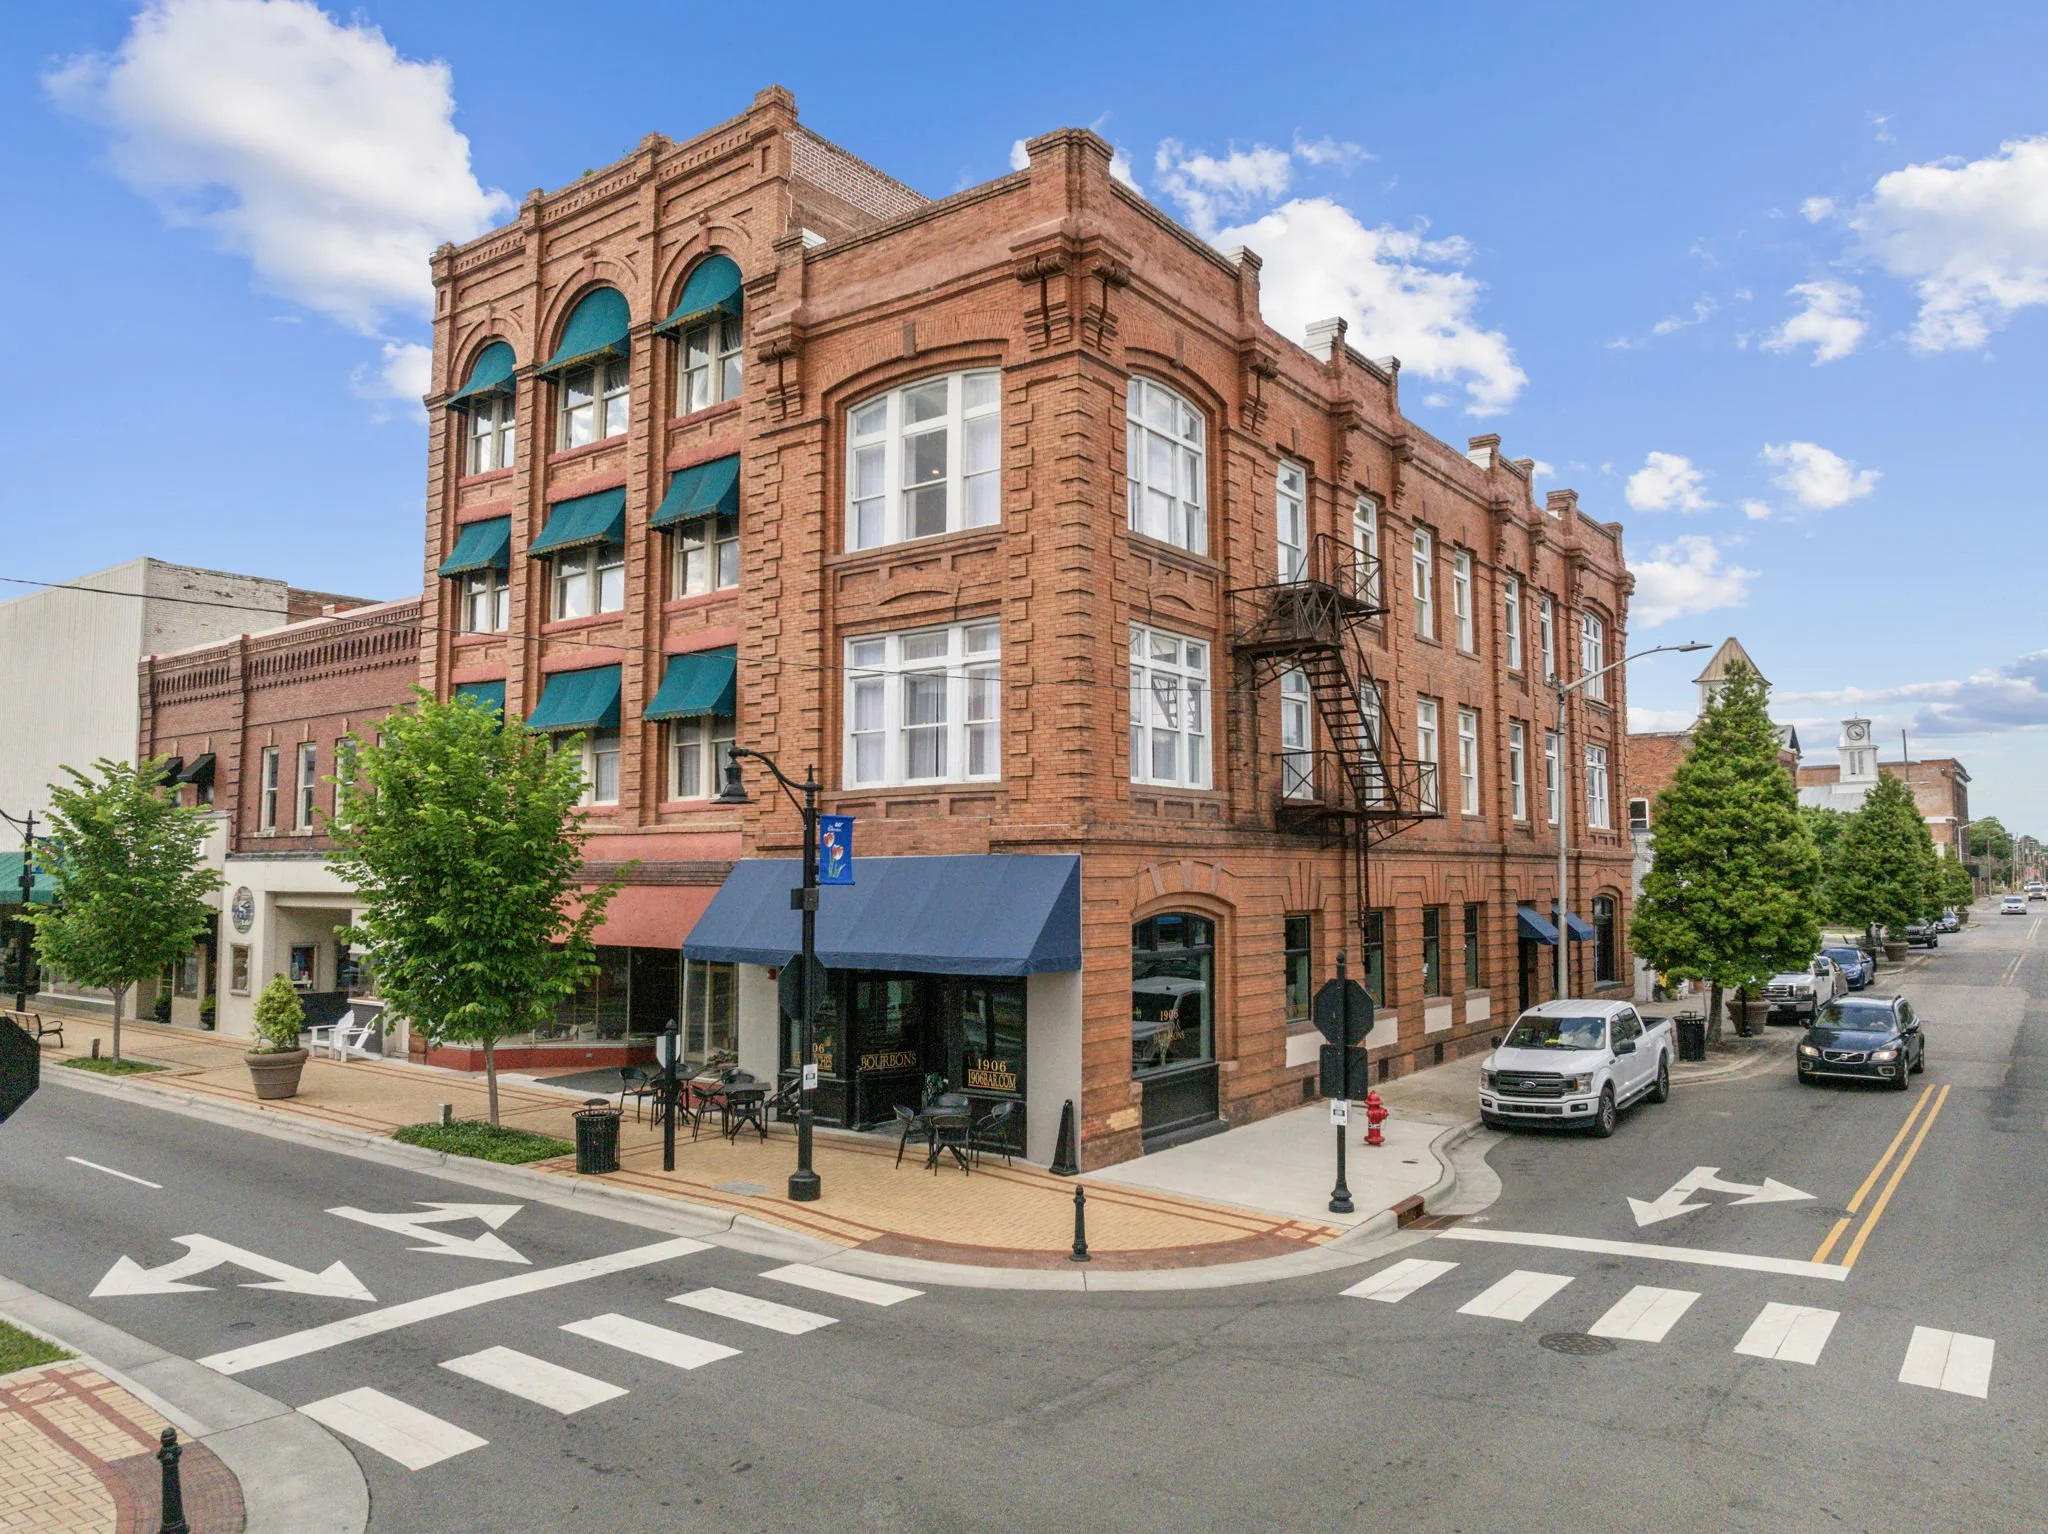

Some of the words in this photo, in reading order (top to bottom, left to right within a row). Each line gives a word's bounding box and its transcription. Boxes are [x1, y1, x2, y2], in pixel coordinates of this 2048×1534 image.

[1161, 1009, 1179, 1021] 1906
[812, 1043, 825, 1053] 06
[861, 1052, 917, 1069] BOURBONS
[978, 1058, 1007, 1072] 1906
[968, 1071, 1016, 1089] 1906BAR.COM
